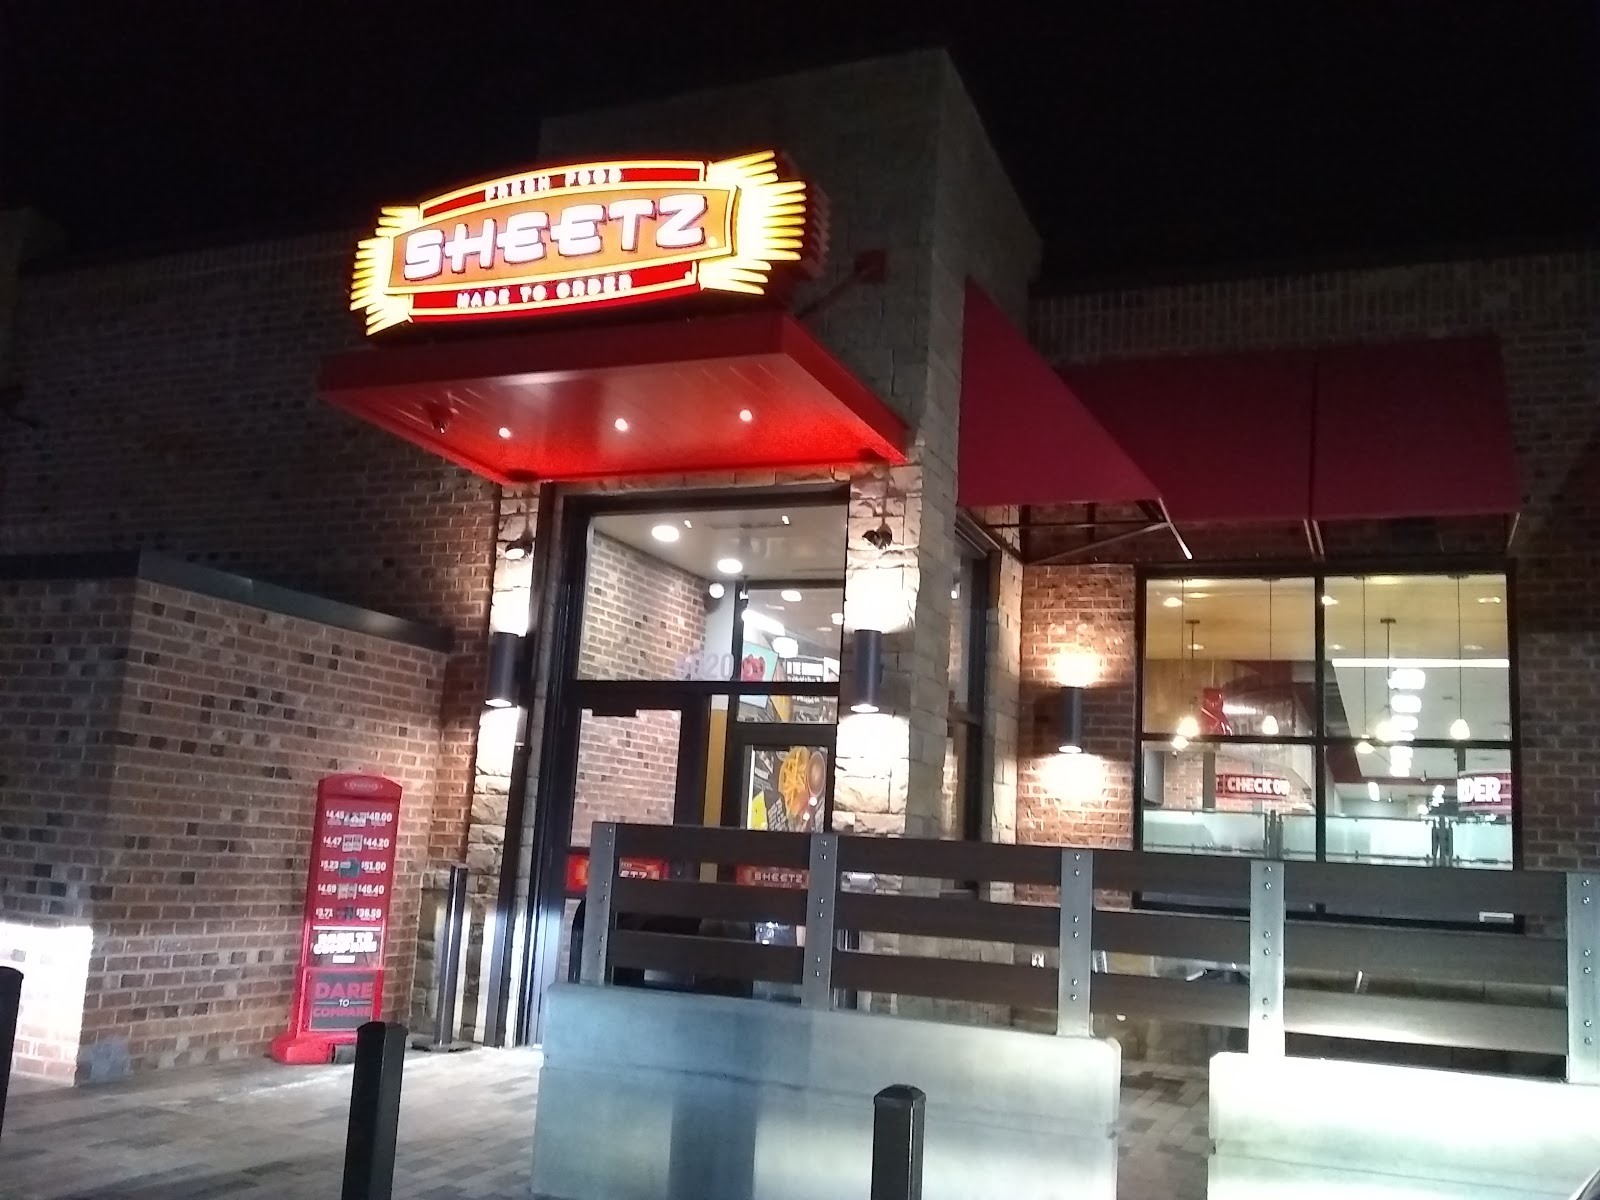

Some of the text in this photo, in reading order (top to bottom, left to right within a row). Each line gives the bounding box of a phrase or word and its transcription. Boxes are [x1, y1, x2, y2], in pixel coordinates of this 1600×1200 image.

[403, 193, 709, 280] SHEETZ
[456, 273, 633, 309] MADE TO ORDER
[1227, 776, 1272, 794] CHECK
[754, 871, 803, 884] SHEETZ
[314, 982, 374, 999] DARE
[338, 998, 350, 1008] TO
